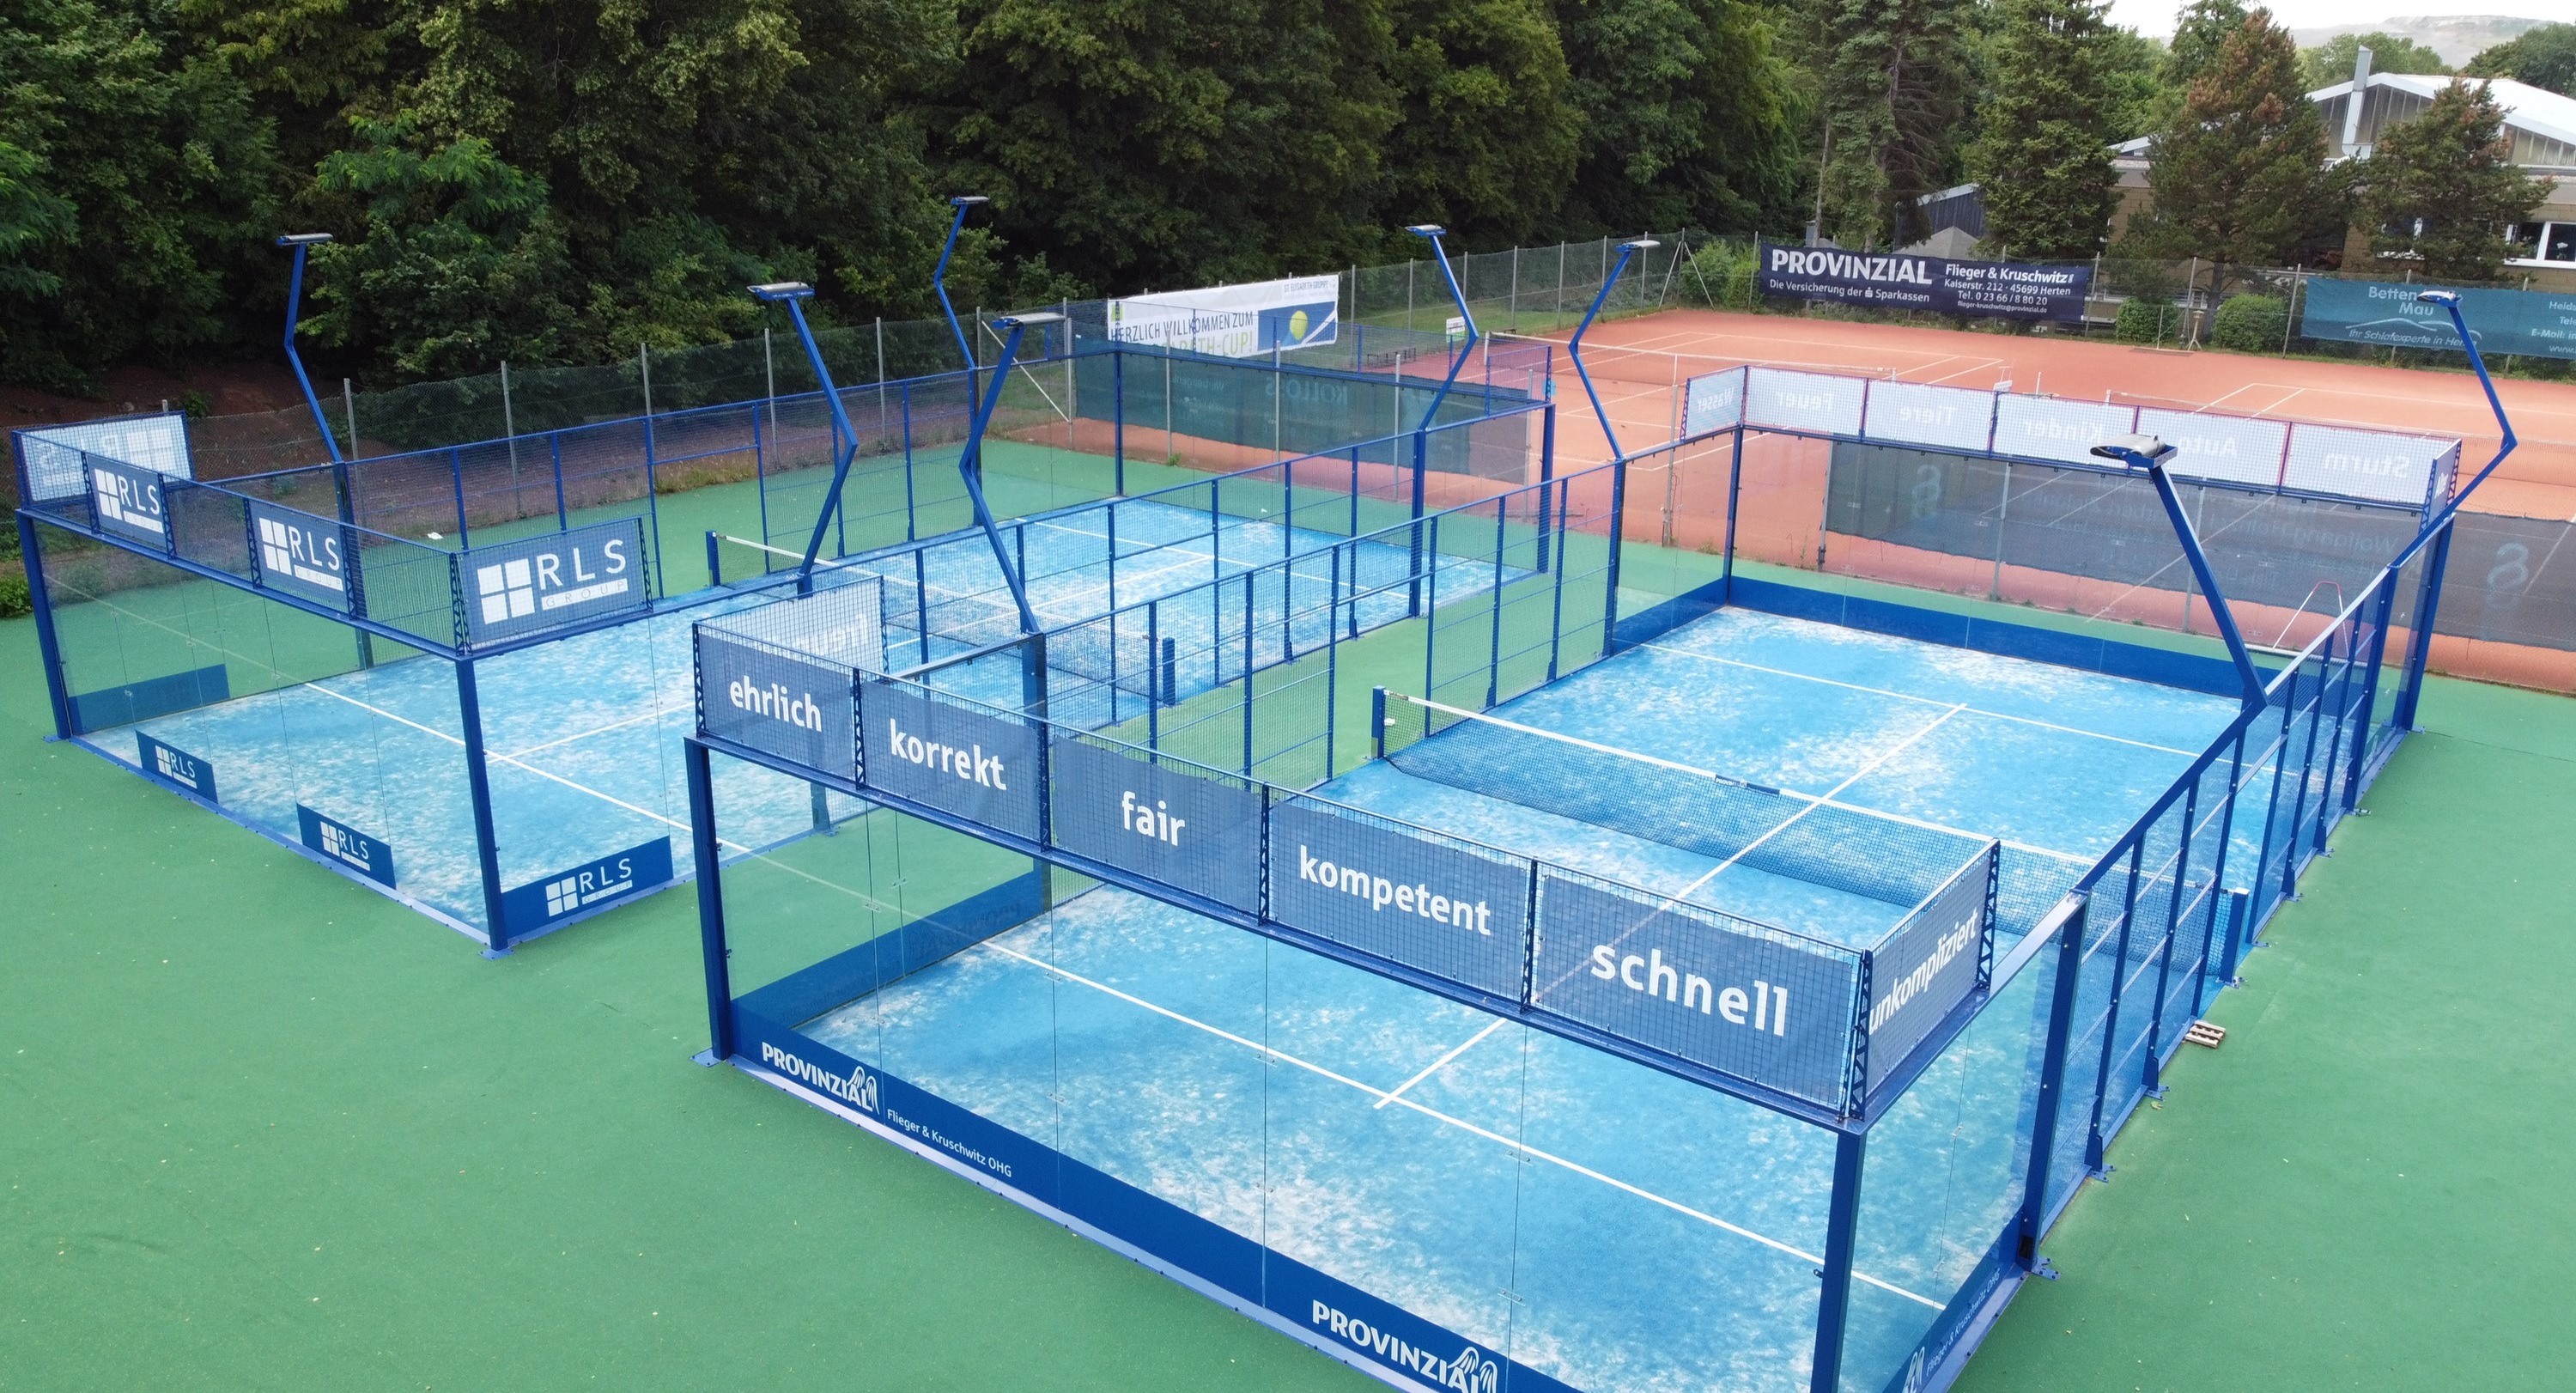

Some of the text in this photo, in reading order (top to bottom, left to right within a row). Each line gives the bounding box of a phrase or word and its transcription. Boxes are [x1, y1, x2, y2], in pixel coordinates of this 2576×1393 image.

[1771, 249, 1932, 285] PROVINZIAL
[1946, 264, 1986, 280] Flieger
[1988, 267, 1997, 279] &
[2000, 268, 2068, 283] Kruschwitz
[1770, 278, 1929, 302] Die Versicherung der Sparkassen
[1944, 278, 2071, 295] Kaiserstr. 212 45699 Herten
[1958, 290, 1973, 300] Tel.
[1975, 292, 1982, 301] 0
[1984, 293, 1995, 301] 23
[1996, 294, 2008, 303] 66
[2014, 295, 2020, 303] 8
[2024, 295, 2034, 304] 80
[2036, 296, 2048, 306] 20
[2368, 286, 2417, 301] Betten
[2398, 302, 2434, 315] Mau
[1111, 311, 1254, 343] HERZLICH WILLKOMMEN ZUM
[2348, 329, 2362, 338] Ihr
[2364, 331, 2431, 344] Schlafexperte
[2433, 336, 2443, 344] in
[2531, 328, 2566, 338] E-Mail:
[117, 474, 161, 515] RLS
[288, 525, 339, 572] RLS
[537, 538, 626, 591] RLS
[546, 581, 625, 608] GROUP
[730, 675, 822, 733] ehrlich
[169, 751, 196, 778] RLS
[890, 718, 1007, 791] korrekt
[1121, 791, 1186, 847] fair
[338, 829, 369, 860] RLS
[579, 858, 632, 893] RLS
[584, 881, 631, 903] GROUP
[1300, 845, 1491, 937] kompetent
[1869, 906, 1978, 1036] unkompliziert
[1591, 943, 1789, 1037] schnell
[762, 1041, 874, 1112] PROVINZIAL
[887, 1109, 1012, 1177] Flieger & Kruschwitz OHG
